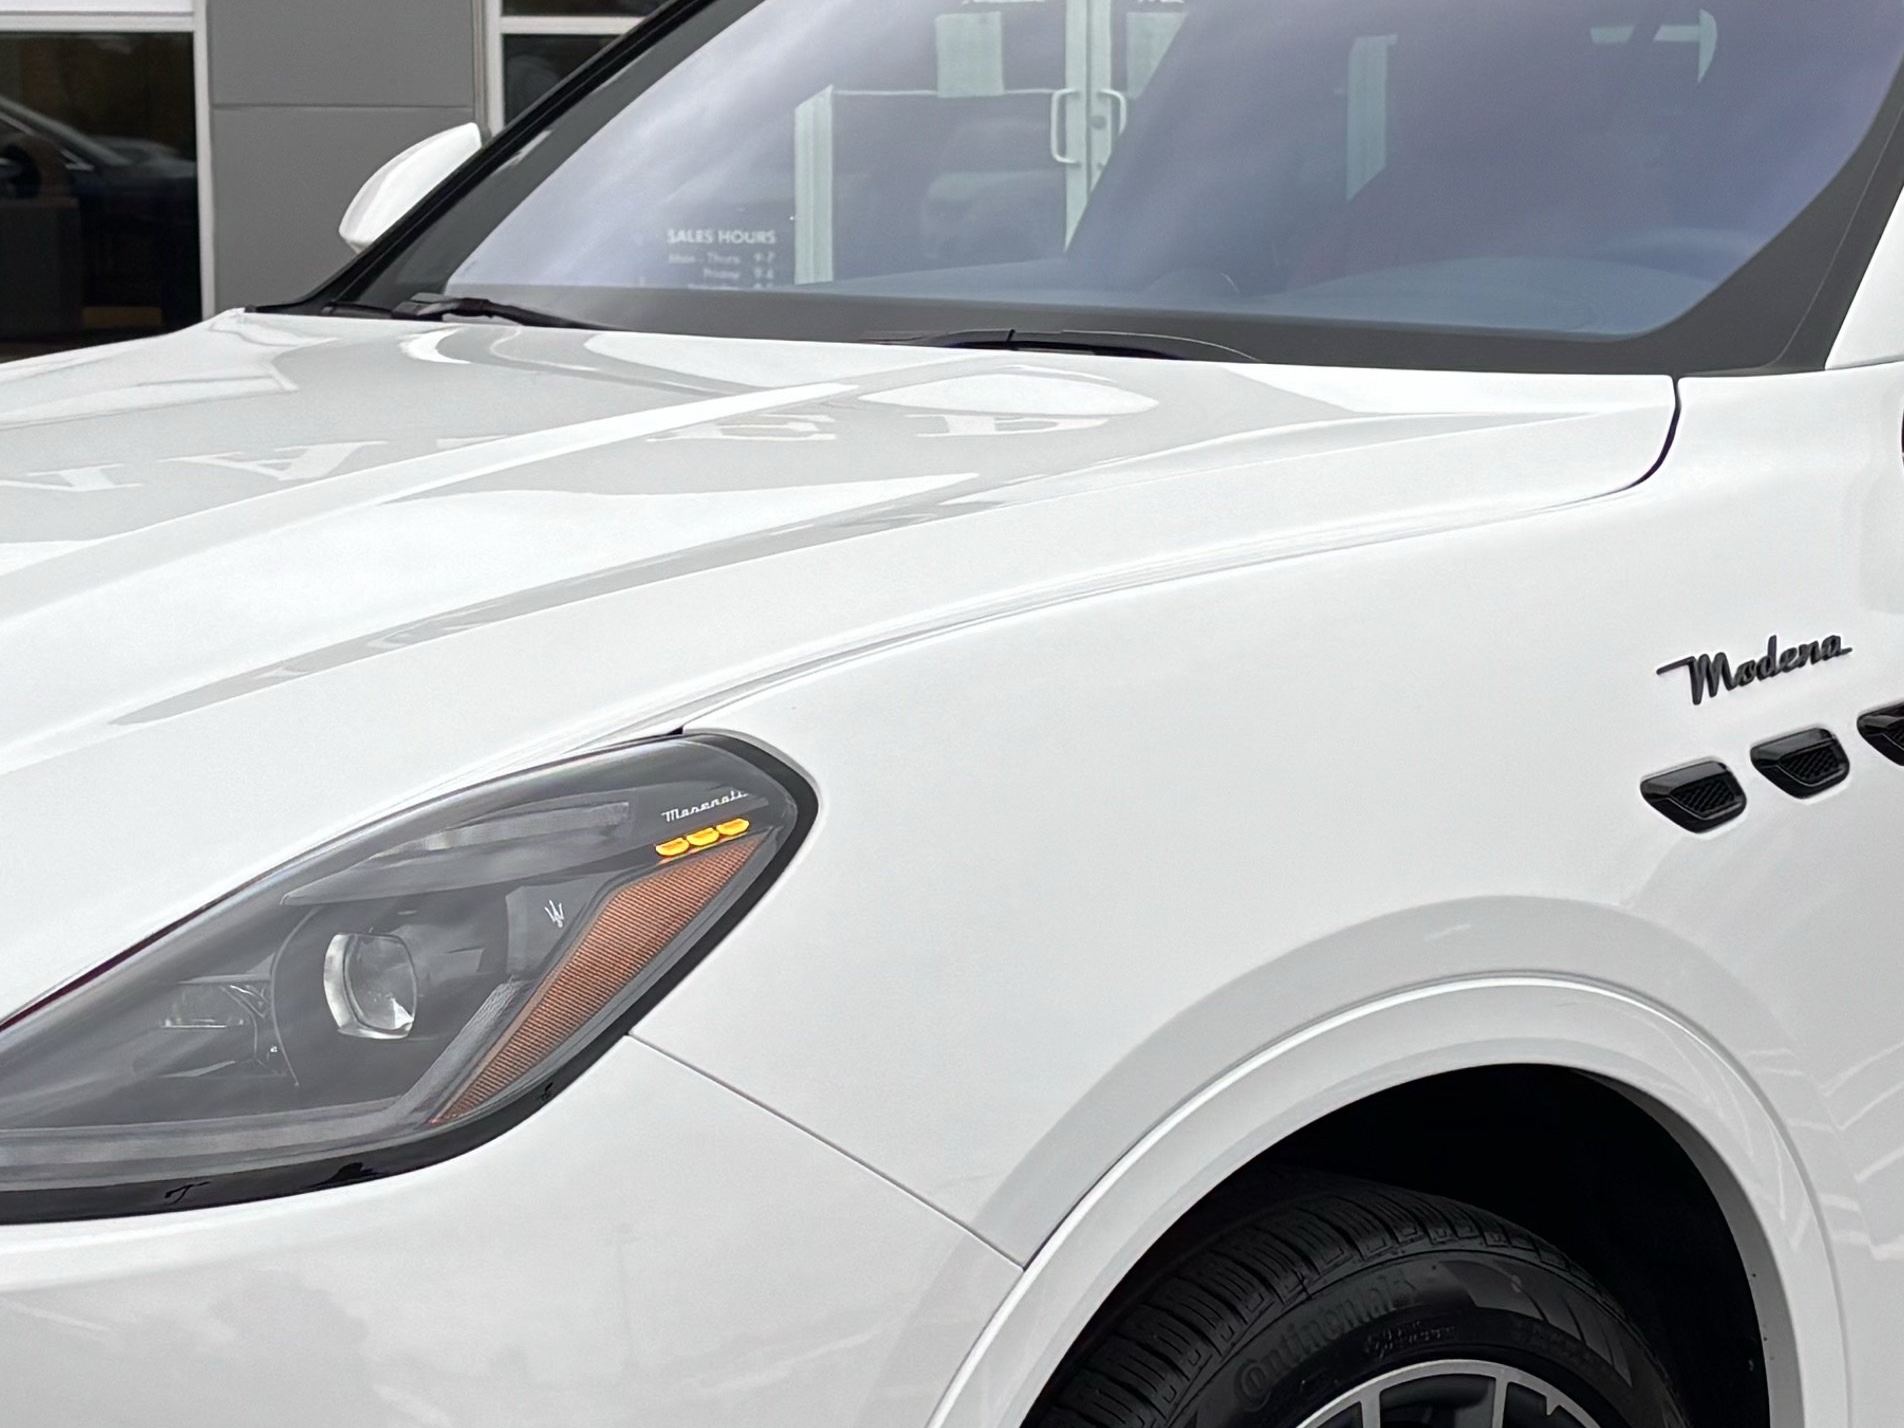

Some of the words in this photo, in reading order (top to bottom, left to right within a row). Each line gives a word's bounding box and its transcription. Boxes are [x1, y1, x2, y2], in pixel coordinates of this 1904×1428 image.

[667, 229, 714, 244] SALES
[718, 229, 776, 244] HOURS
[1656, 634, 1853, 706] Modena
[661, 789, 750, 823] Maserati
